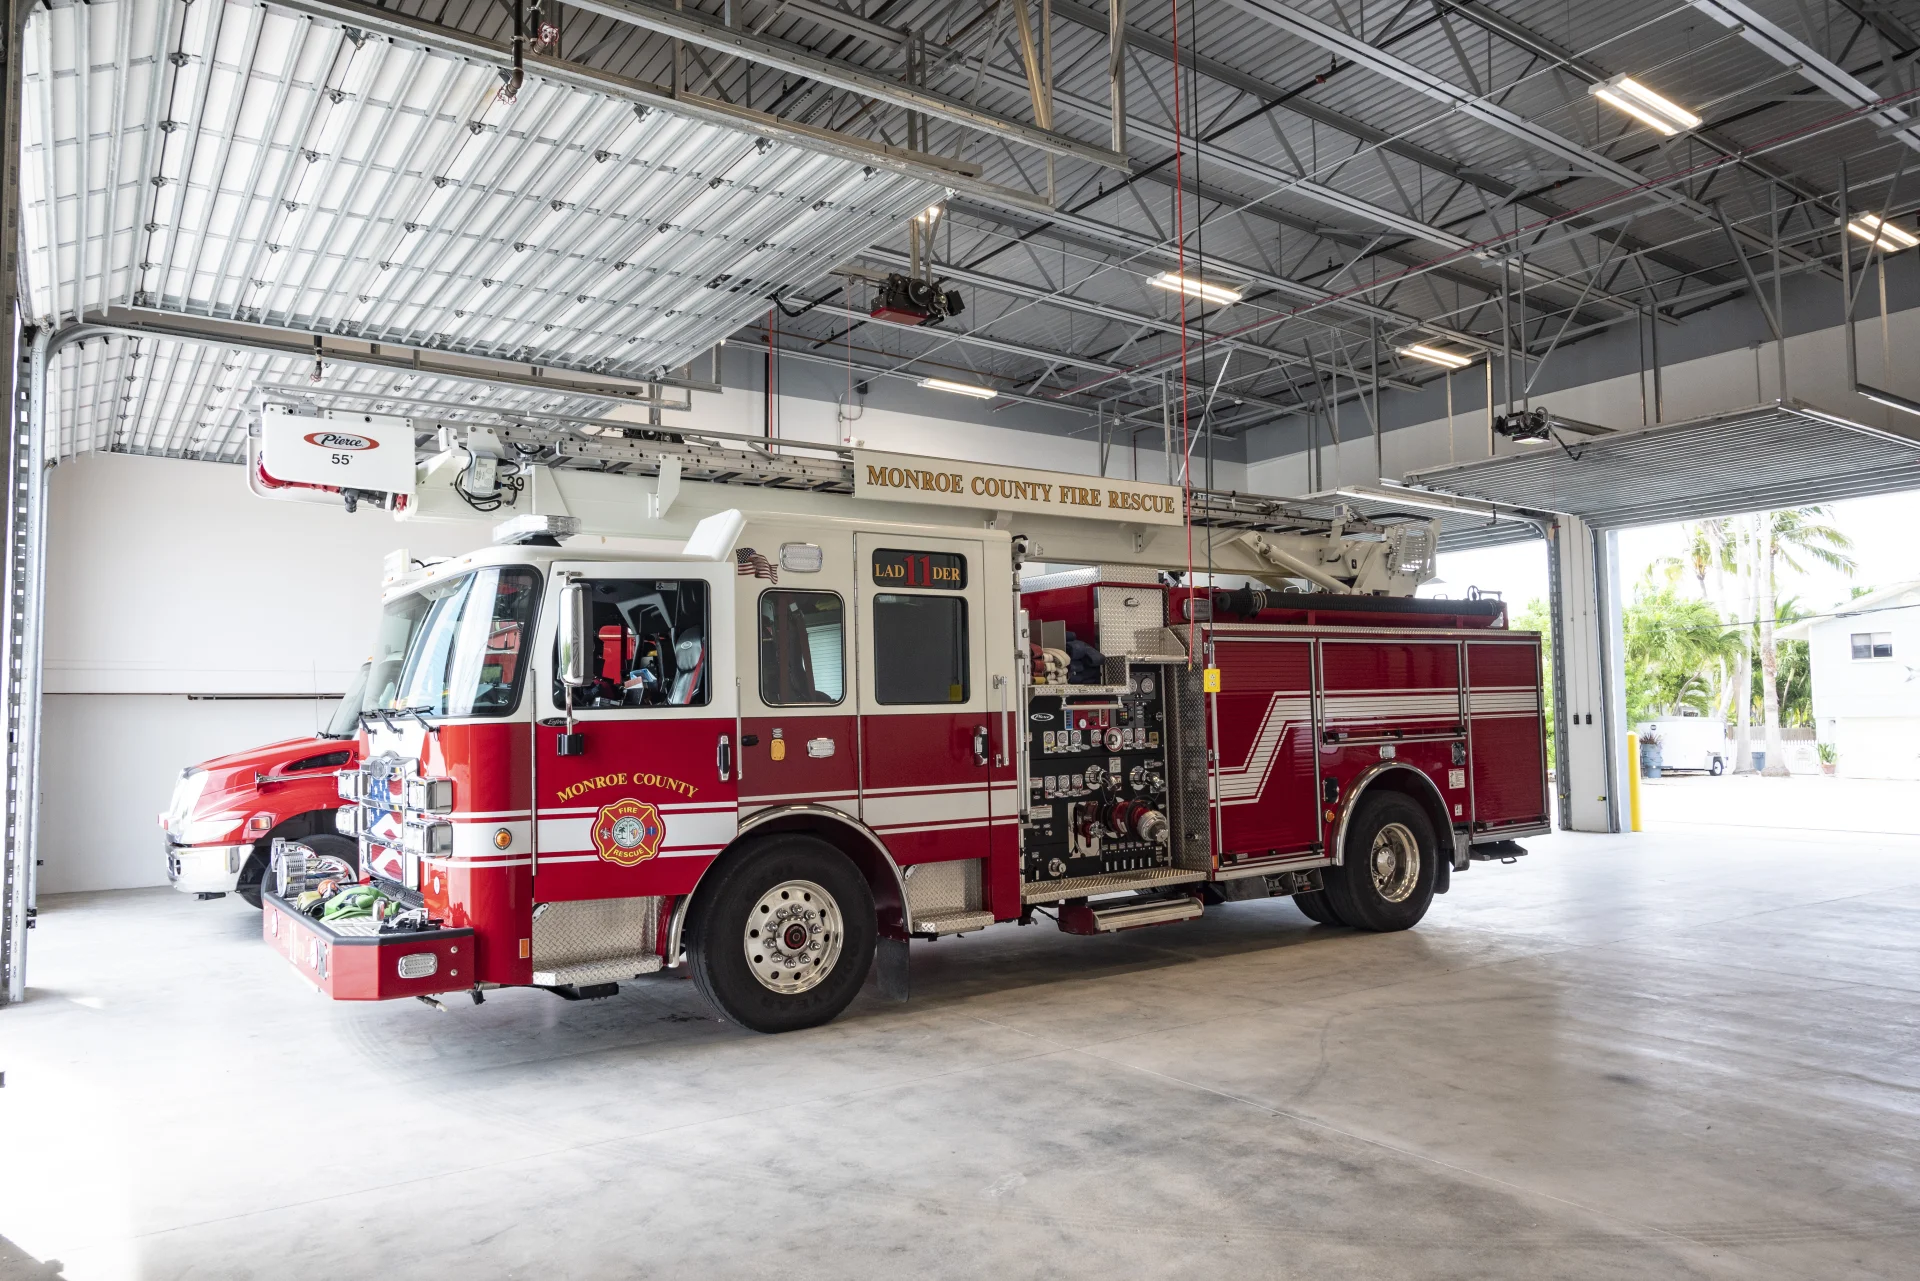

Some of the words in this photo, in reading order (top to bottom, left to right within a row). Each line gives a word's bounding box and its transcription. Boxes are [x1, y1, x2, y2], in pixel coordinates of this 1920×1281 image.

[321, 433, 363, 447] Pierce
[507, 475, 525, 491] 39
[866, 464, 964, 494] MONROE
[971, 476, 1052, 502] COUNTY
[1059, 485, 1102, 507] FIRE
[1107, 490, 1175, 514] RESCUE
[875, 563, 905, 578] LAD
[903, 554, 934, 587] 11
[932, 566, 961, 581] DER
[556, 772, 628, 803] MONROE
[633, 772, 699, 798] COUNTY
[618, 806, 638, 814] FIRE
[613, 848, 644, 858] RESCUE
